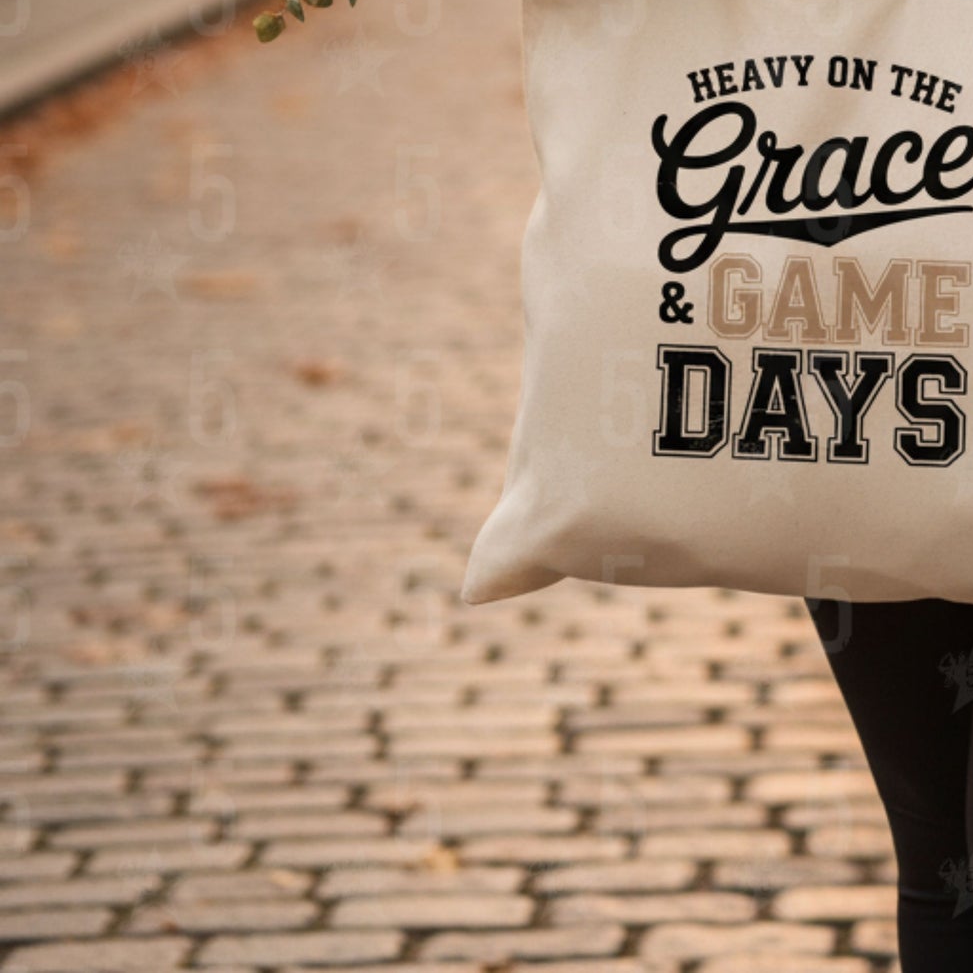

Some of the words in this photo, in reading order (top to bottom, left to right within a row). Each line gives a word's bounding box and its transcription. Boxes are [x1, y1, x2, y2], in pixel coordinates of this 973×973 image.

[686, 54, 815, 103] HEAVY
[827, 55, 878, 91] ON
[890, 64, 963, 113] THE
[658, 280, 694, 325] &
[707, 252, 972, 347] GAME
[652, 343, 968, 468] DAYS
